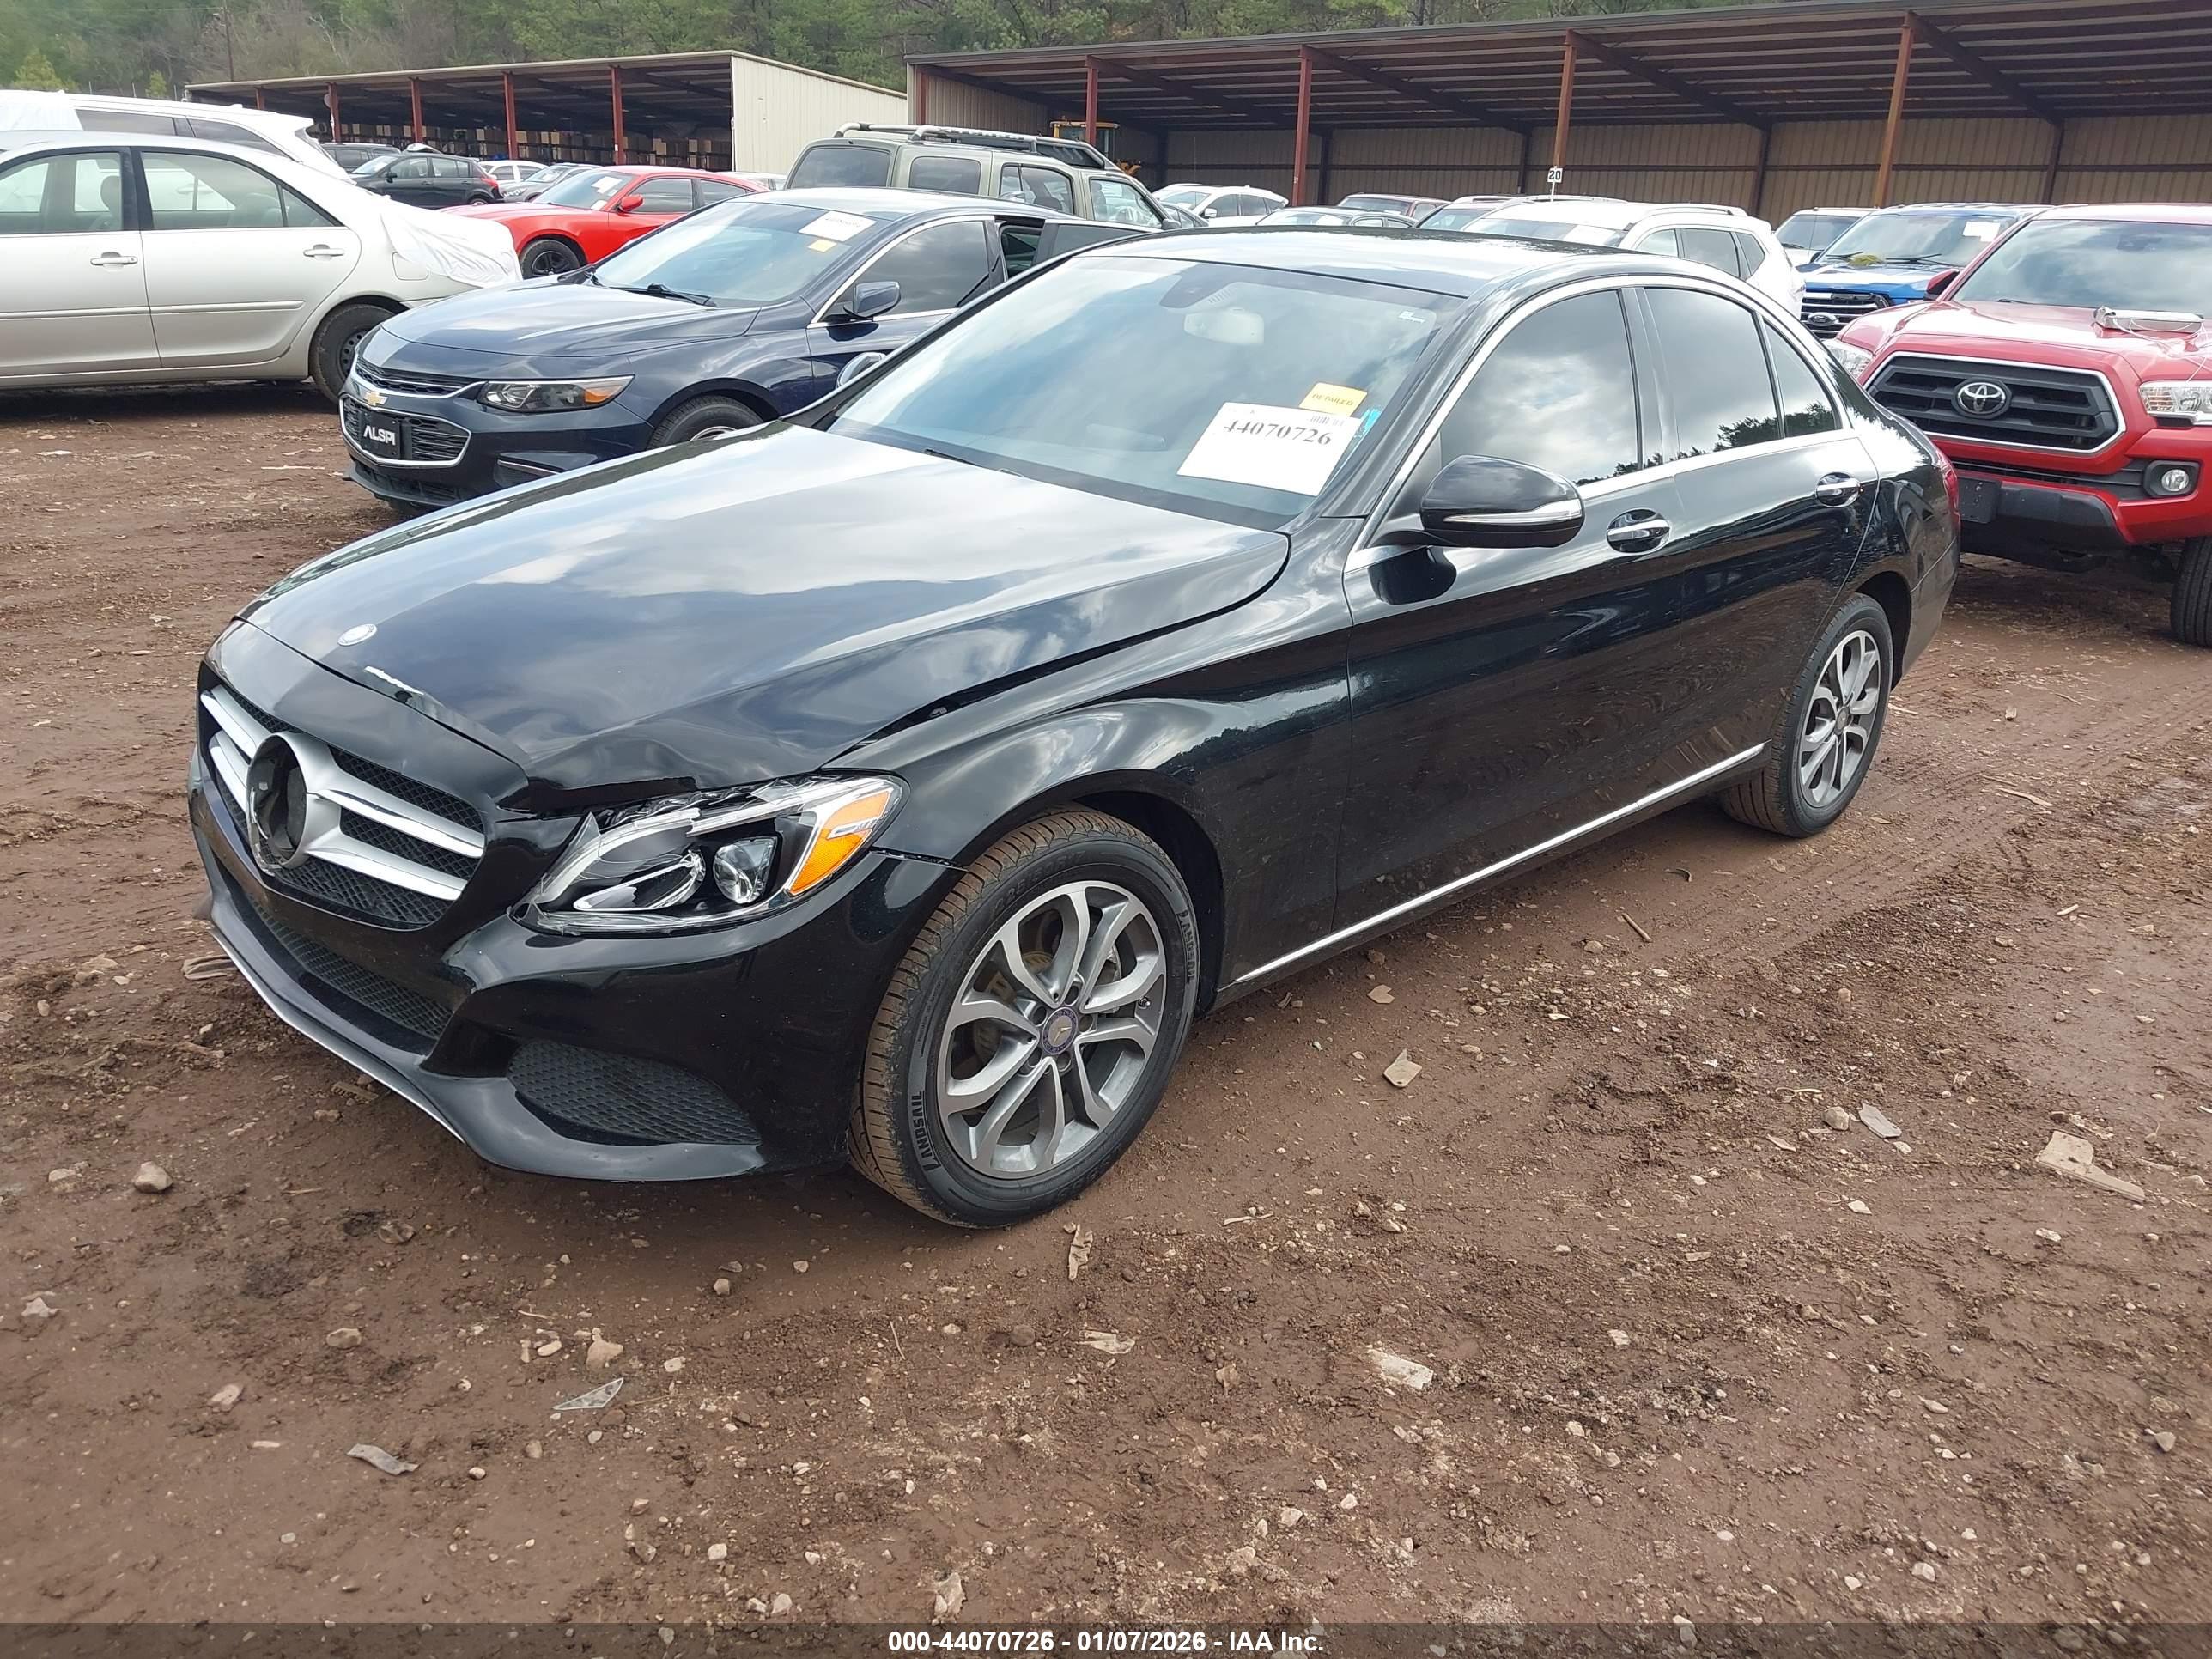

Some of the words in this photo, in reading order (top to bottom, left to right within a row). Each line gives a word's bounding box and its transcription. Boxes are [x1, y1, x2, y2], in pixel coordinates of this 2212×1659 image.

[1549, 170, 1561, 180] 20
[363, 425, 396, 446] ALSPI
[1224, 419, 1333, 445] 44070726
[911, 1090, 942, 1172] LANDSAIL
